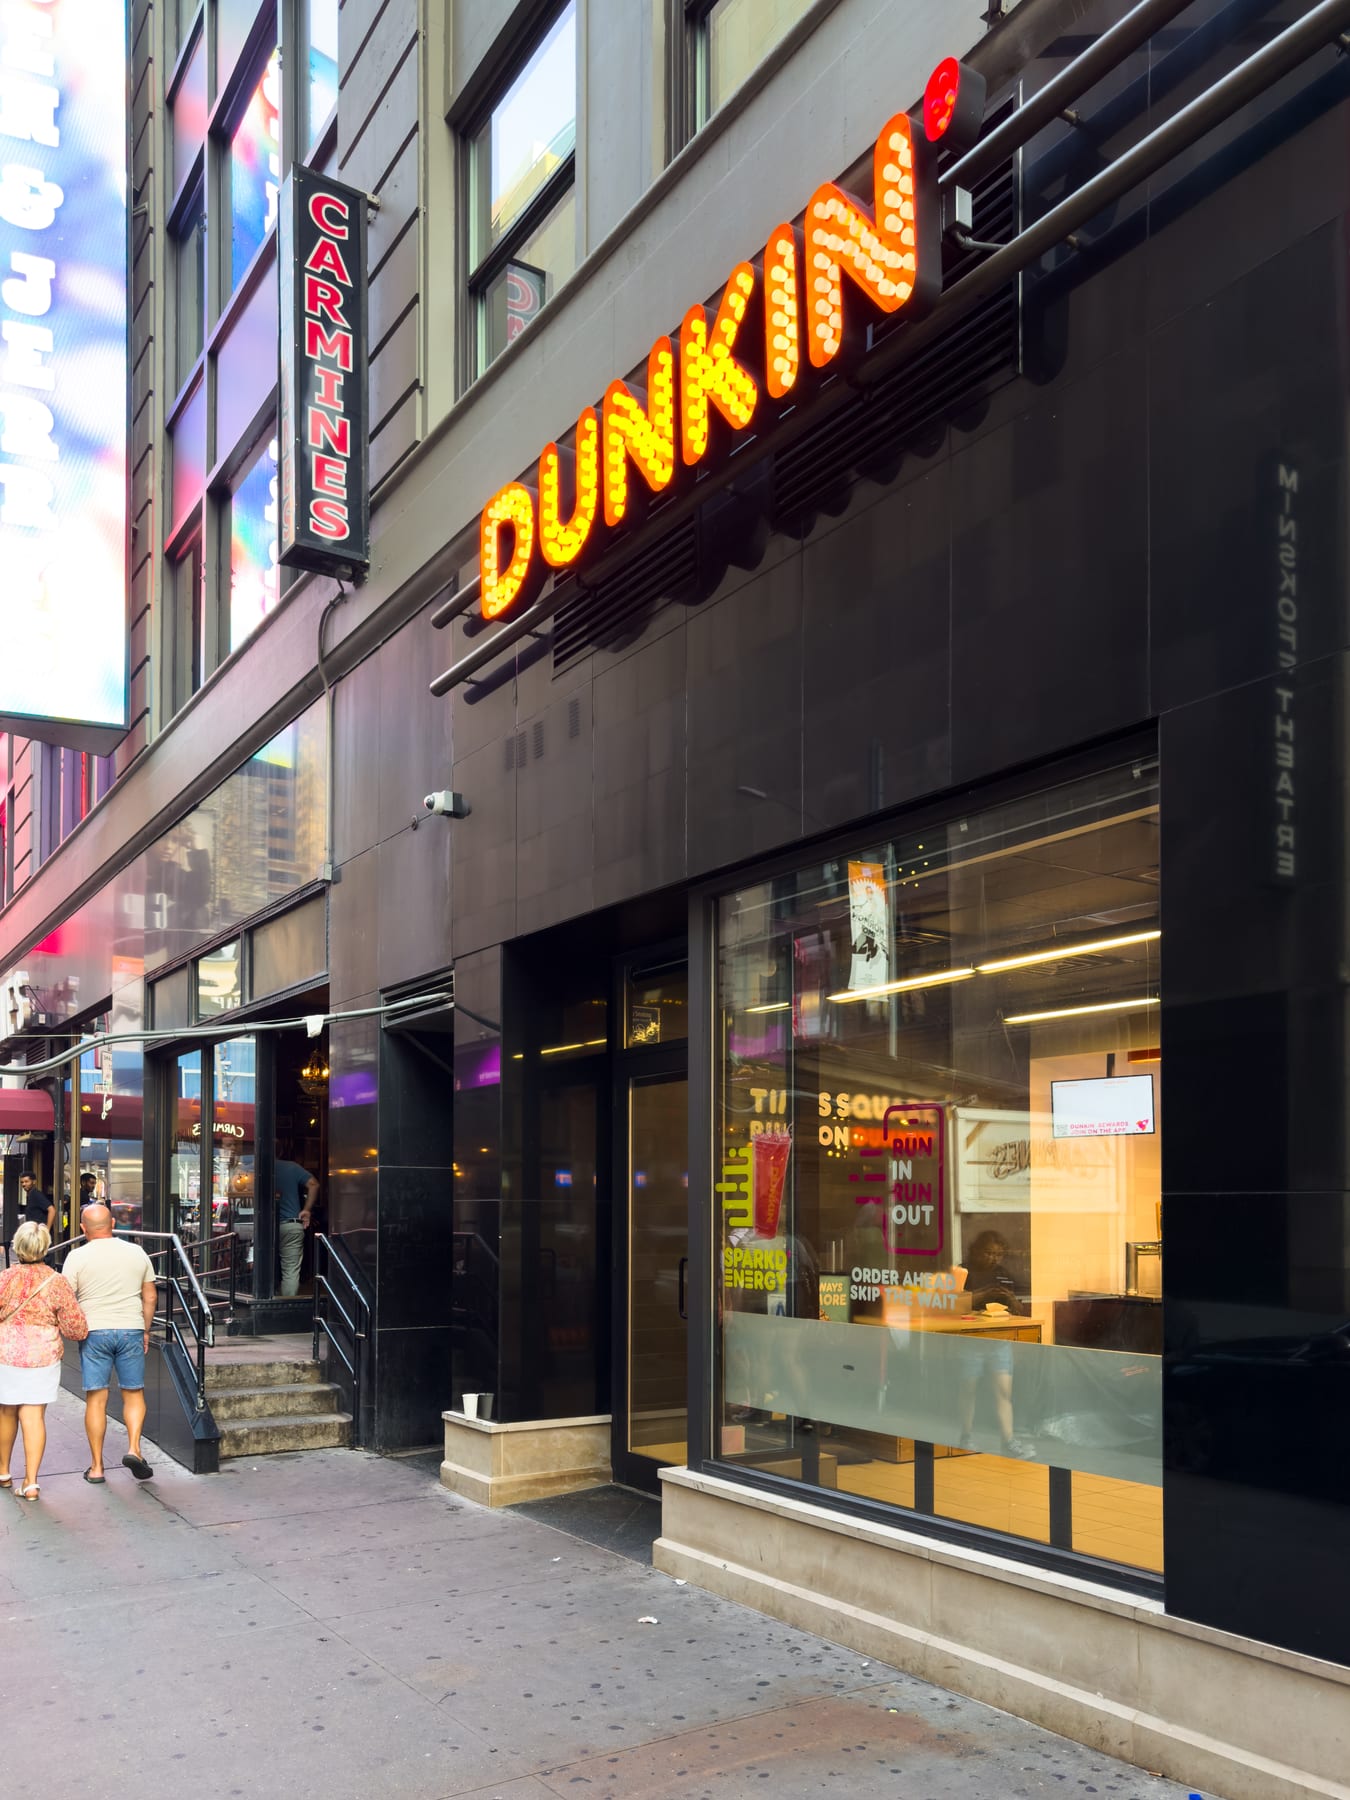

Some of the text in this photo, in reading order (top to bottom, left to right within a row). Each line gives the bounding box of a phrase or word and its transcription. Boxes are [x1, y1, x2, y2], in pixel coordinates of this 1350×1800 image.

[305, 193, 353, 542] CARMINES
[818, 1125, 849, 1147] ON
[893, 1137, 933, 1157] RUN
[892, 1159, 912, 1180] IN
[893, 1183, 932, 1203] RUN
[891, 1204, 934, 1226] OUT
[724, 1268, 788, 1291] ENERGY
[851, 1266, 957, 1291] ORDER AHEAD
[850, 1284, 958, 1311] SKIP THE WAIT
